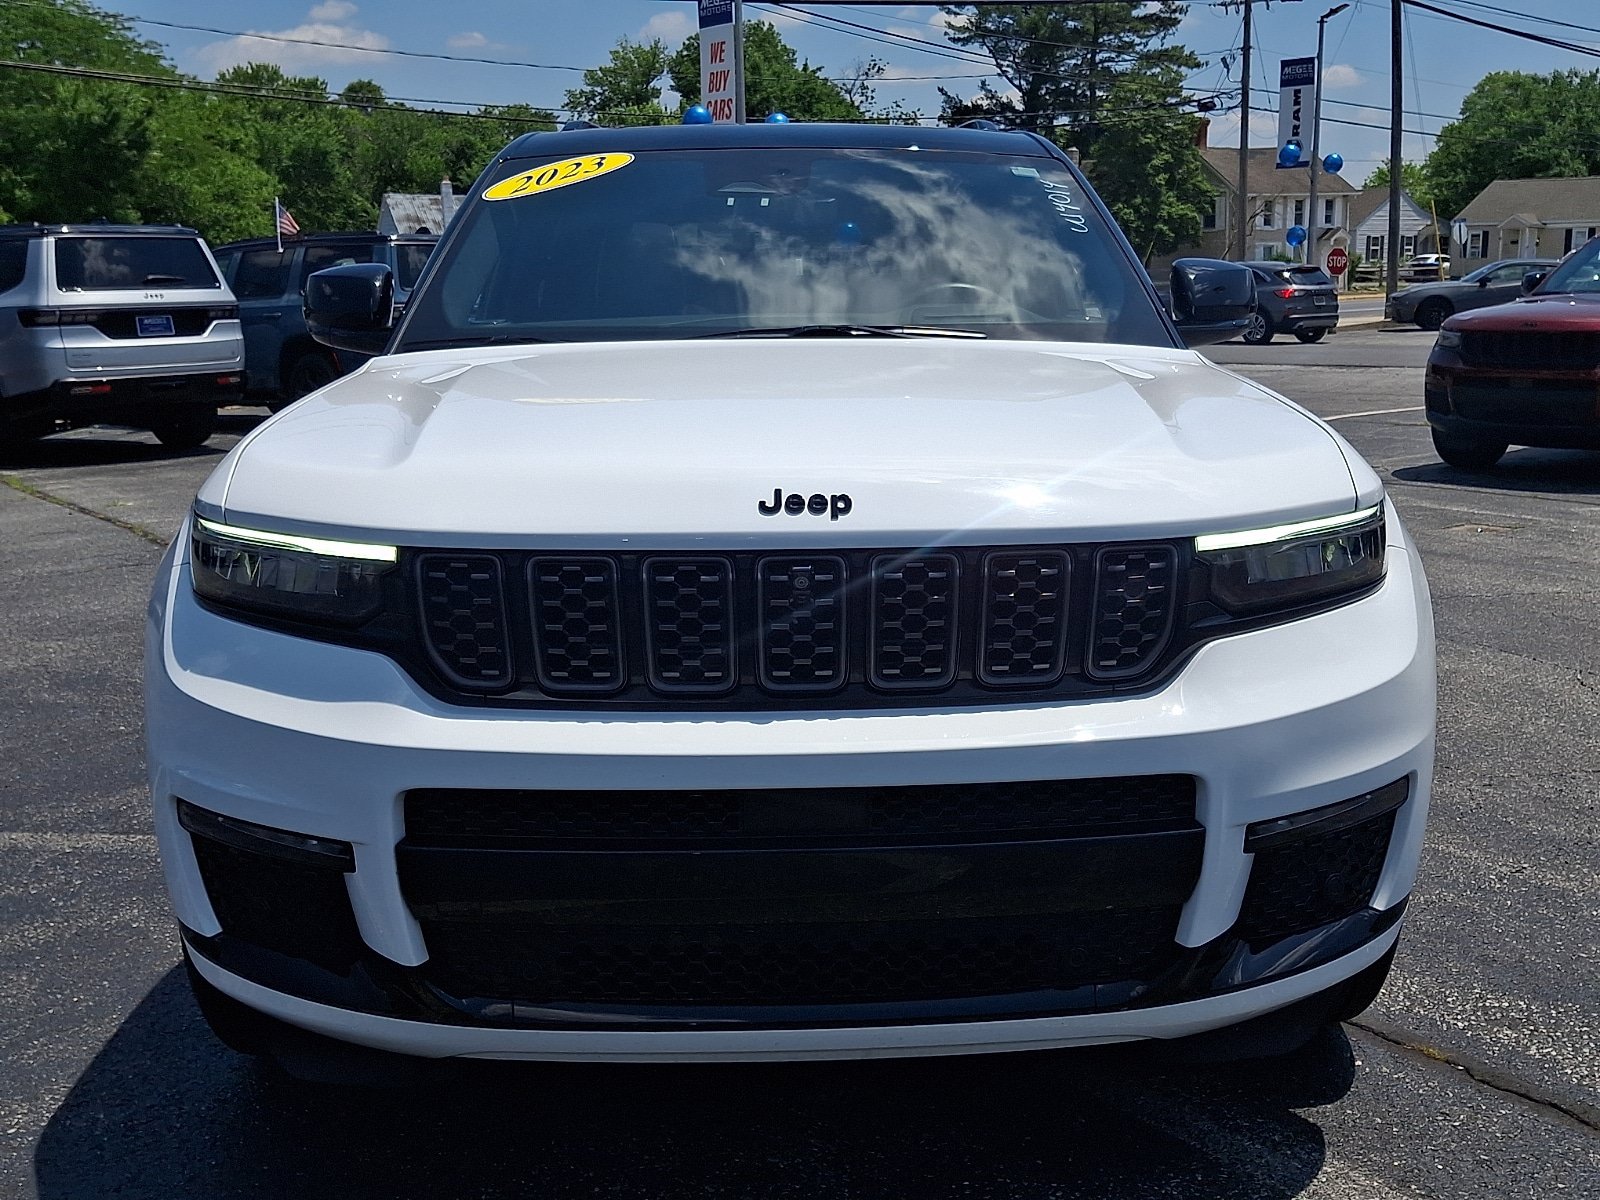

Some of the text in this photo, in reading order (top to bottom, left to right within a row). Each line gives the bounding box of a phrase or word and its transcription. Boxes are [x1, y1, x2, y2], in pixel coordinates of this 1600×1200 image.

[700, 4, 732, 17] MOTORS
[710, 41, 726, 64] WE
[1282, 64, 1314, 75] MEGEE
[708, 70, 730, 93] BUY
[1292, 89, 1302, 137] RAM
[509, 157, 607, 195] 2023
[1328, 255, 1347, 268] STOP
[758, 488, 853, 521] Jeep
